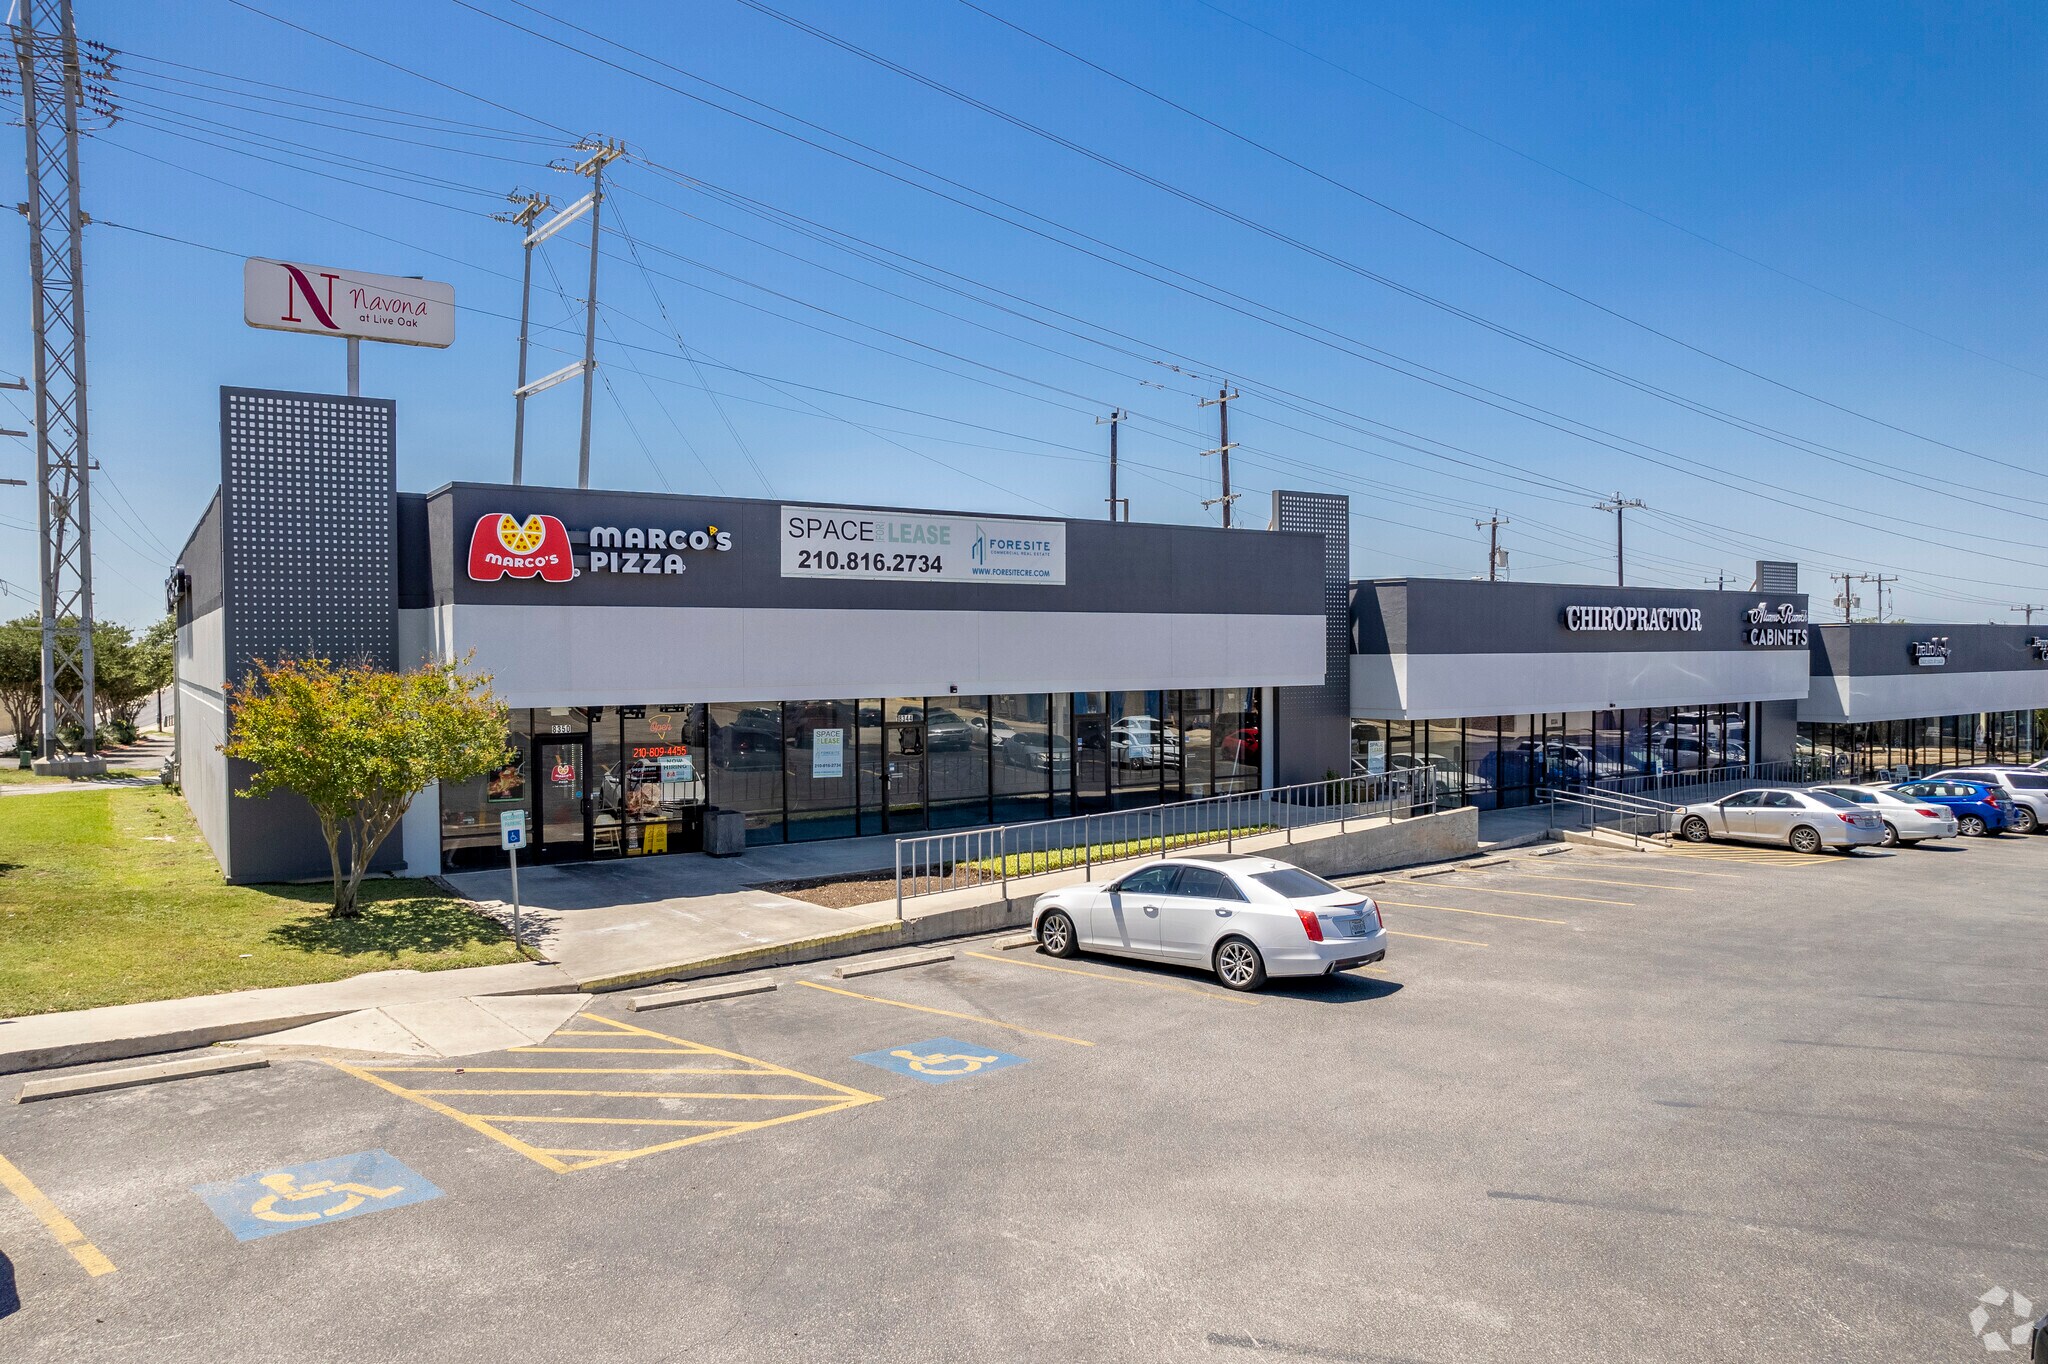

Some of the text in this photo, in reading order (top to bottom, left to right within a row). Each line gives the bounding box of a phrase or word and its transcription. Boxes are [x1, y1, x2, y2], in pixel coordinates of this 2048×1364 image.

[280, 264, 341, 329] N
[350, 288, 427, 316] Navona
[359, 314, 418, 328] at Live Oak
[589, 526, 733, 551] MARCO'S
[788, 517, 875, 542] SPACE
[888, 523, 951, 545] LEASE
[990, 539, 1051, 551] FORESITE
[485, 553, 559, 568] MARCO'S
[590, 551, 684, 574] PIZZA
[798, 550, 943, 574] 210.816.2734
[972, 567, 1051, 577] WWW.FORESITECRE.COM
[1566, 606, 1702, 632] CHIROPRACTOR
[1750, 628, 1808, 646] CABINETS
[551, 724, 572, 734] 8350
[815, 730, 841, 738] SPACE
[820, 737, 841, 745] LEASE
